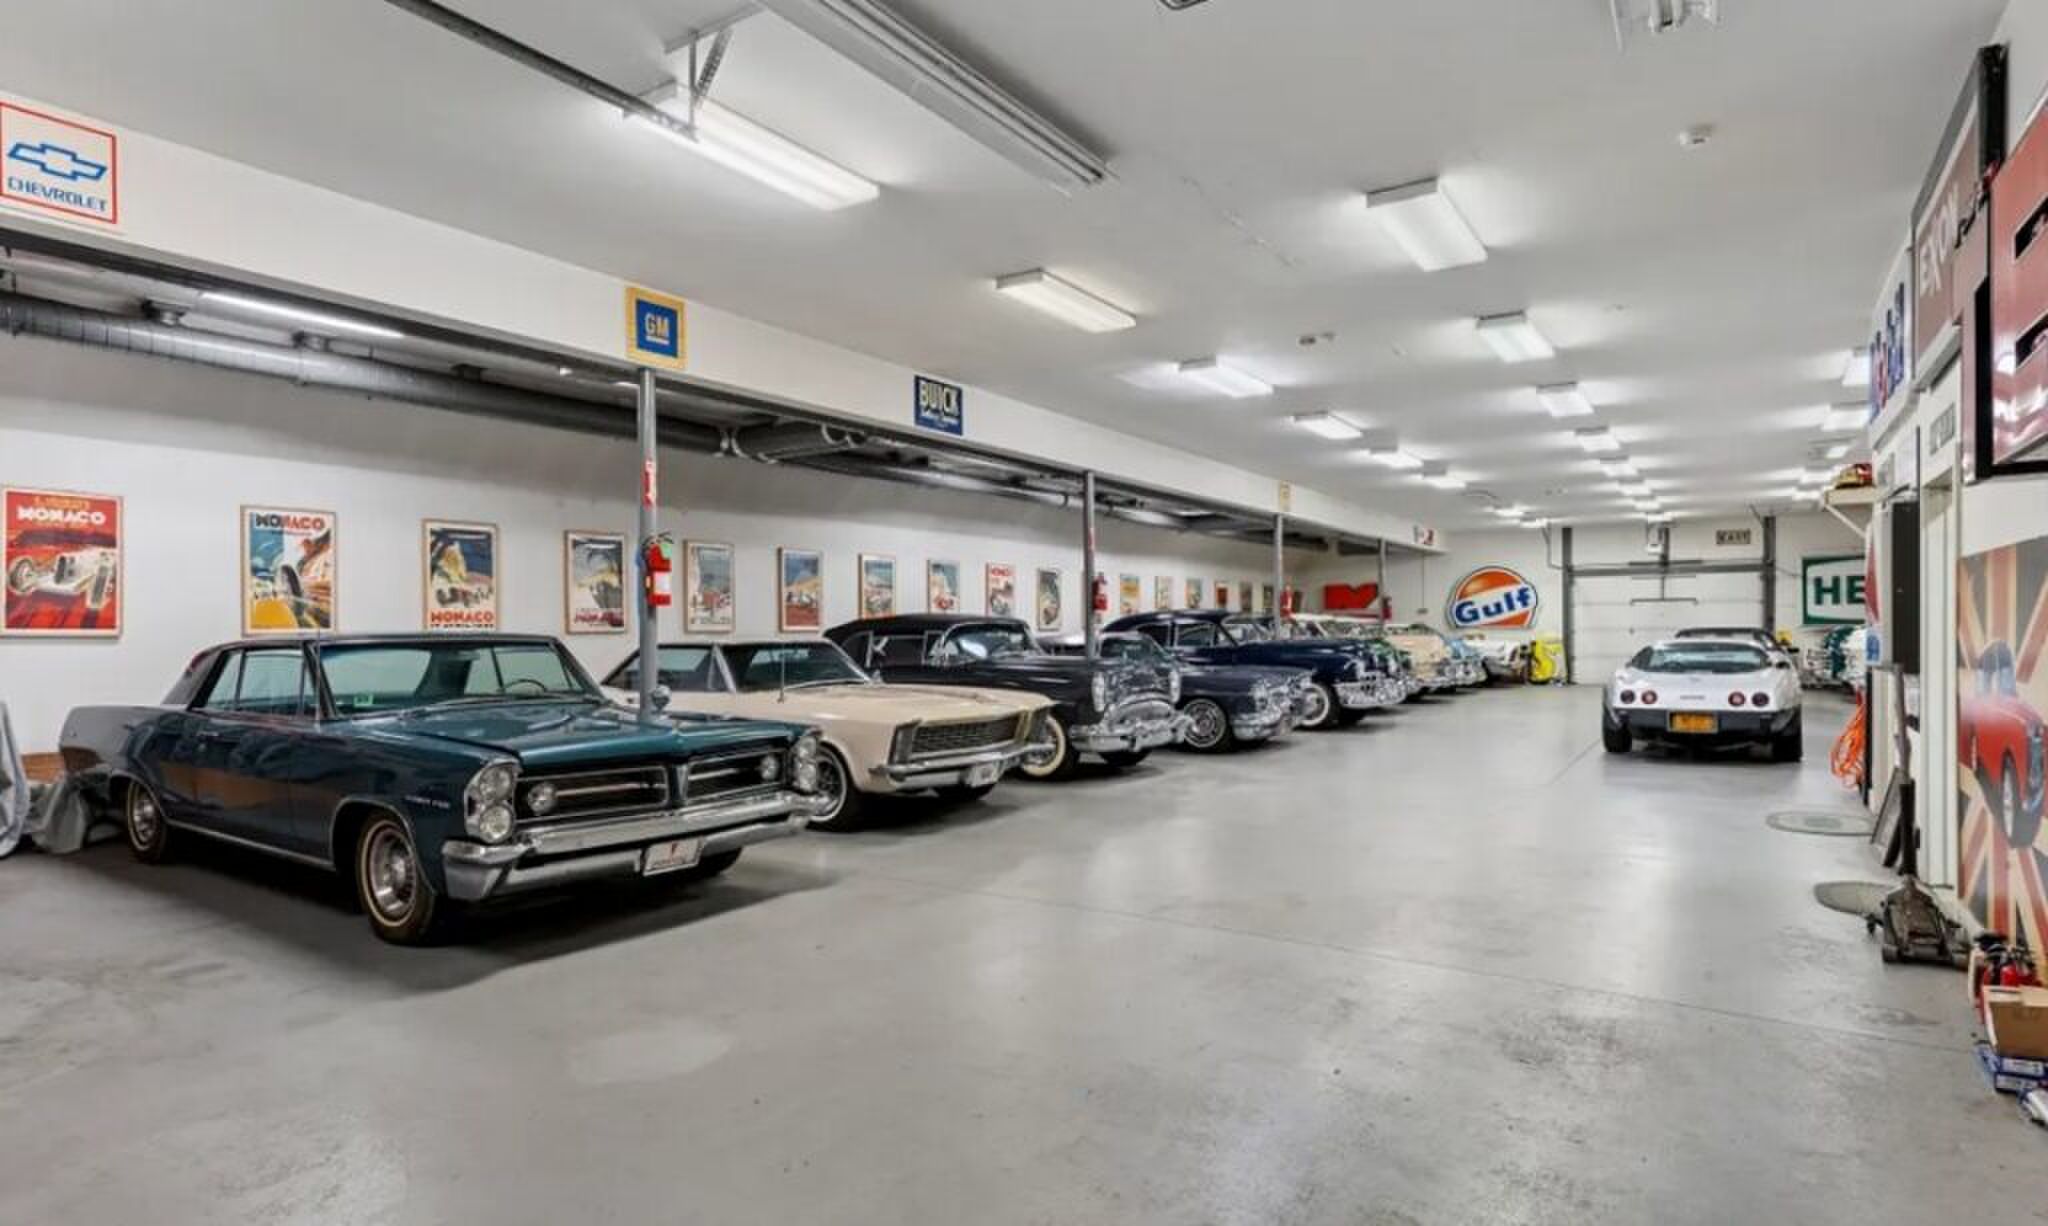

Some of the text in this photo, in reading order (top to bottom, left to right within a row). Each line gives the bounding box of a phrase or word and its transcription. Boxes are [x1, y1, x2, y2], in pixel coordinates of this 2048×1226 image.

[7, 176, 108, 212] CHEVROLET
[644, 312, 670, 339] GM
[919, 380, 959, 416] BUICK
[16, 505, 106, 525] MONACO
[255, 513, 325, 530] MONACO
[431, 611, 494, 623] MONACO
[1455, 587, 1534, 625] Gulf
